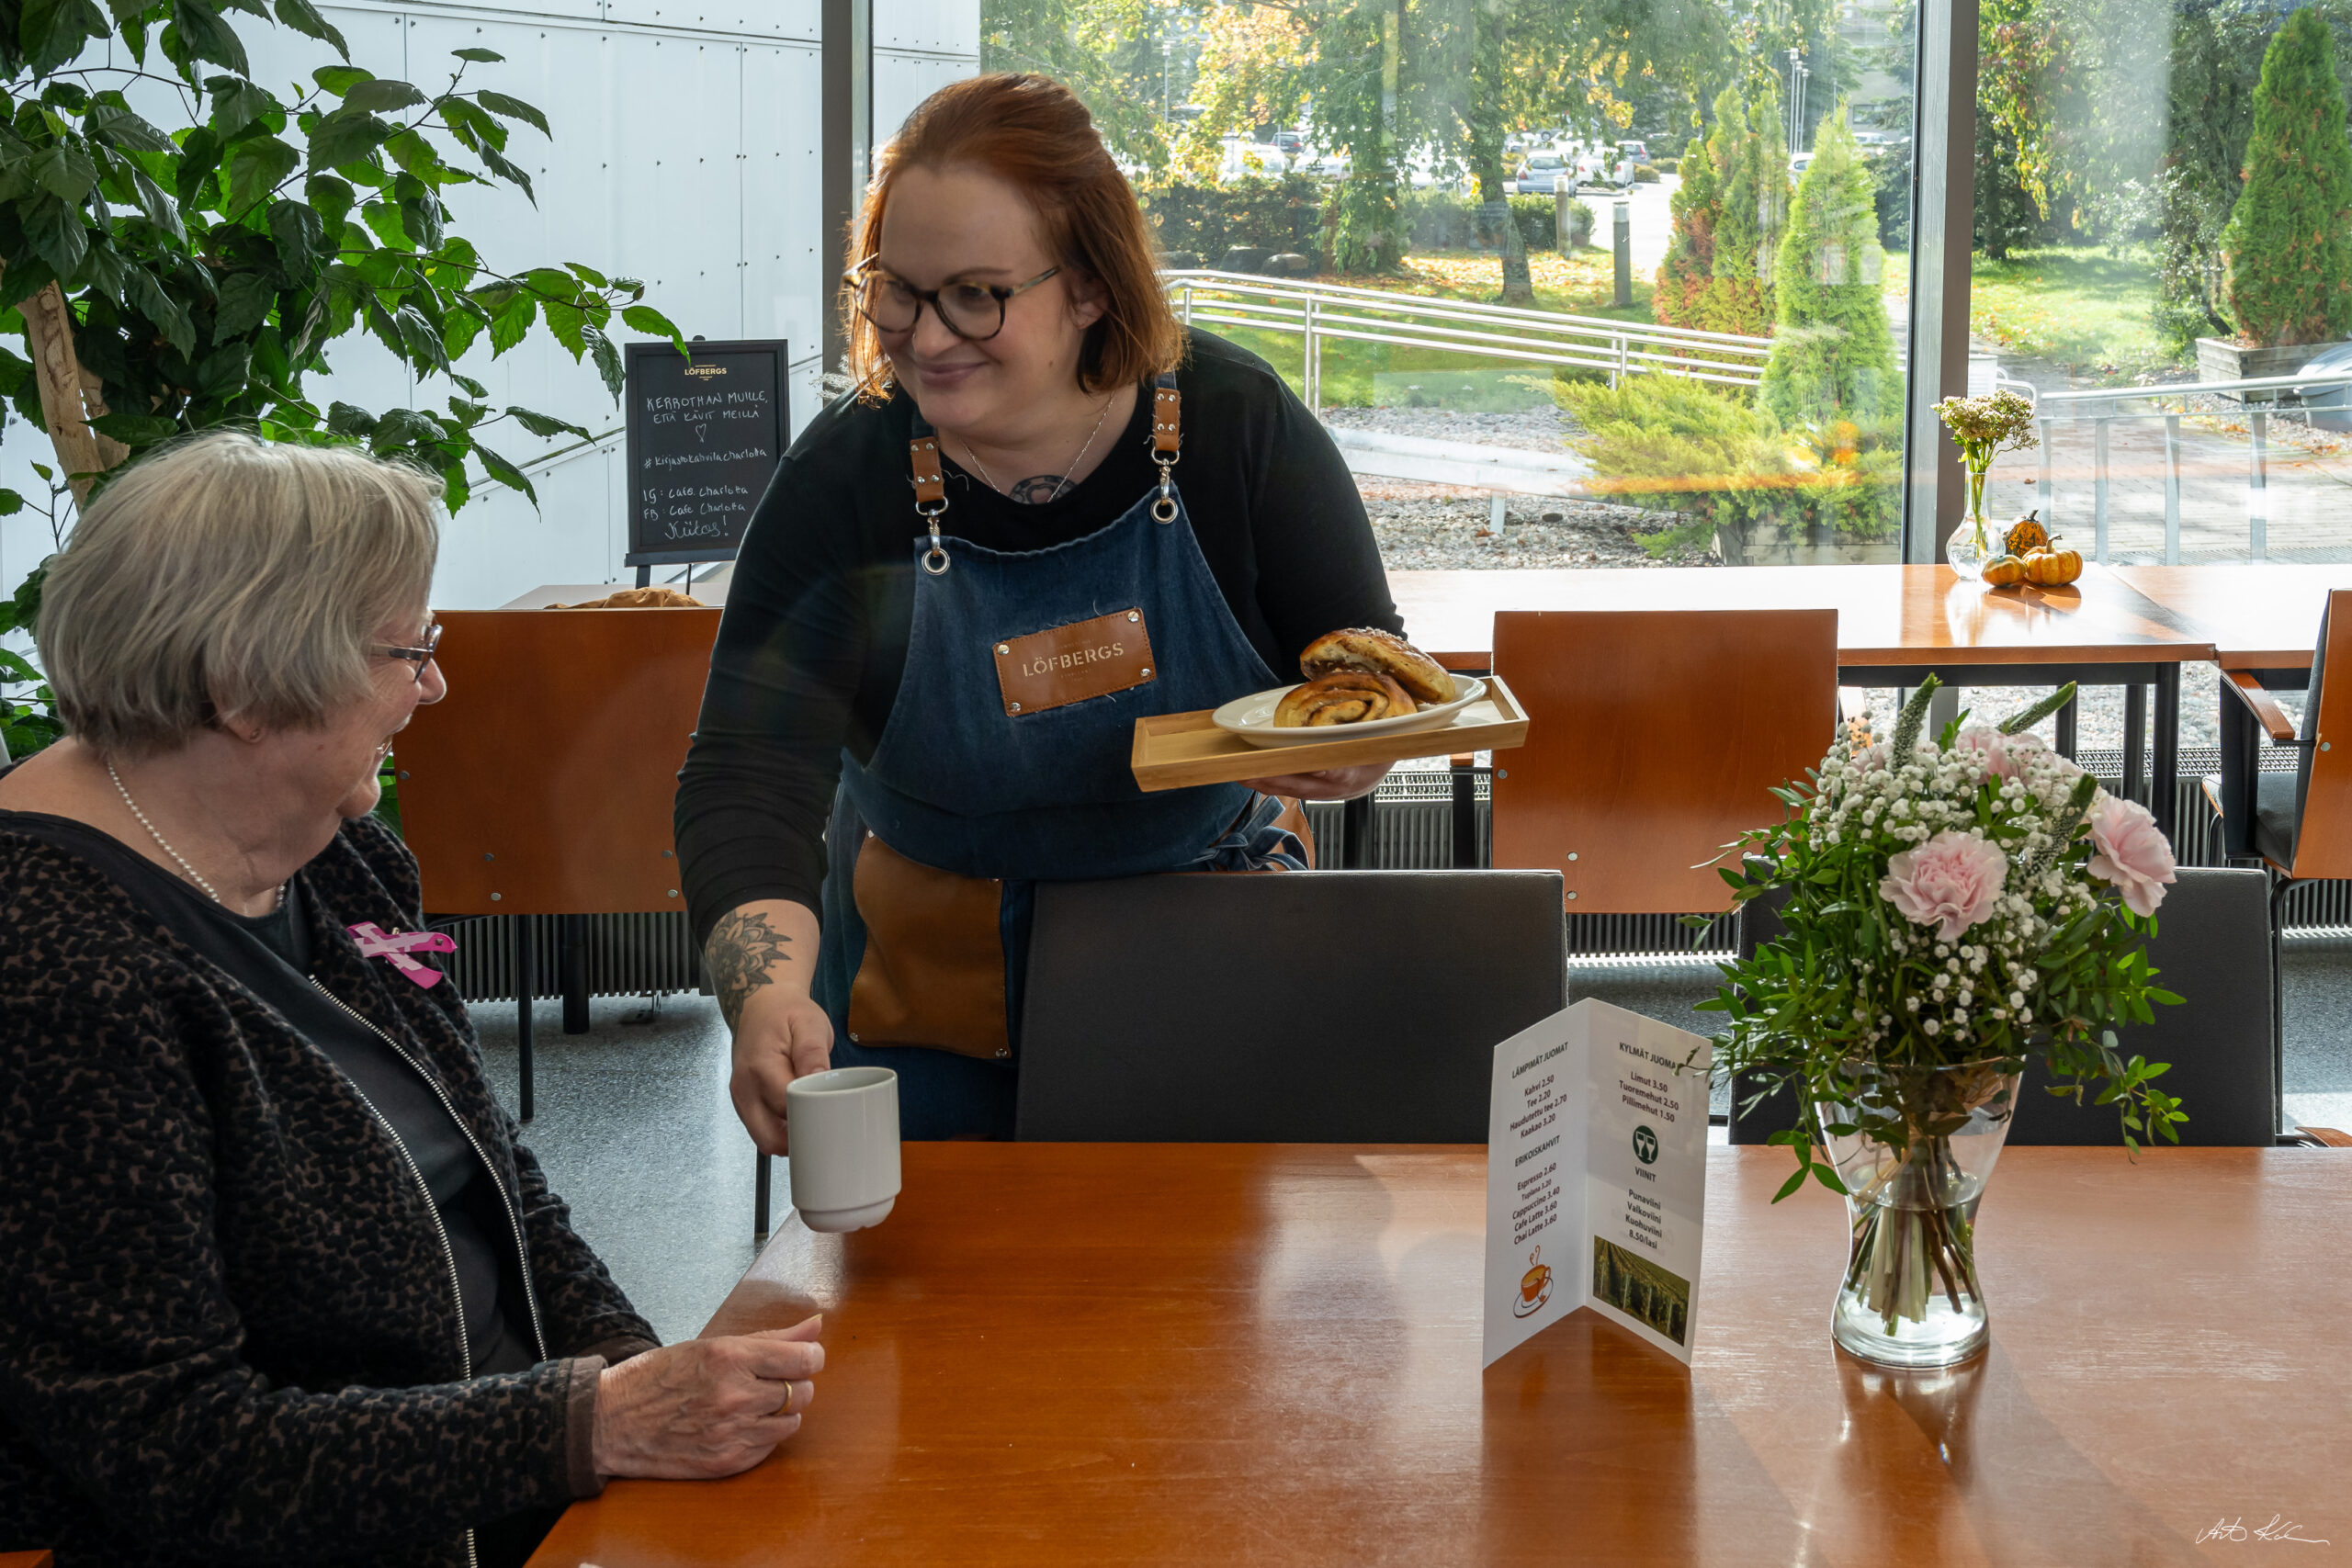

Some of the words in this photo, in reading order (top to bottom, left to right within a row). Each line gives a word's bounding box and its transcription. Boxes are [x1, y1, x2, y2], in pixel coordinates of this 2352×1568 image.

[684, 367, 727, 376] LÖFBERGS
[647, 392, 722, 412] KERROTHAN
[684, 410, 715, 422] KÄVIT
[723, 404, 760, 419] MEILLÄ
[1023, 642, 1125, 677] LÖFBERGS
[1511, 1055, 1544, 1079] LÄMPIMÄT
[1544, 1042, 1568, 1063] JUOMAT
[1619, 1042, 1649, 1060] KYLMÄT
[1650, 1055, 1677, 1069] JUOMA
[1524, 1080, 1541, 1097] Kahvi
[1542, 1074, 1555, 1088] 2.50
[1619, 1079, 1663, 1104] Tuoremehut
[1663, 1097, 1679, 1111] 2.50
[1631, 1071, 1651, 1087] Limut
[1652, 1079, 1668, 1093] 3.50
[1527, 1098, 1538, 1109] Tee
[1538, 1089, 1551, 1102] 2.20
[1623, 1094, 1658, 1116] Pillimehut
[1660, 1110, 1675, 1122] 1.50
[1510, 1108, 1544, 1132] Haudutettu
[1544, 1102, 1554, 1112] tee
[1521, 1122, 1543, 1139] Kaakao
[1514, 1135, 1560, 1168] ERIKOISKAHVIT
[1517, 1171, 1544, 1191] Espresso
[1544, 1162, 1556, 1176] 2.60
[1634, 1167, 1657, 1182] VIINIT
[1512, 1195, 1546, 1220] Cappuccino
[1547, 1186, 1560, 1200] 3.40
[1629, 1189, 1661, 1210] Punaviini
[1514, 1218, 1528, 1232] Cafe
[1528, 1210, 1544, 1224] Latte
[1544, 1201, 1557, 1214] 3.60
[1514, 1231, 1528, 1245] Chai
[1528, 1223, 1544, 1236] Latte
[1544, 1213, 1557, 1227] 3.60
[1625, 1213, 1662, 1238] Kuohuviini
[1629, 1229, 1657, 1249] 8.50/lasi
